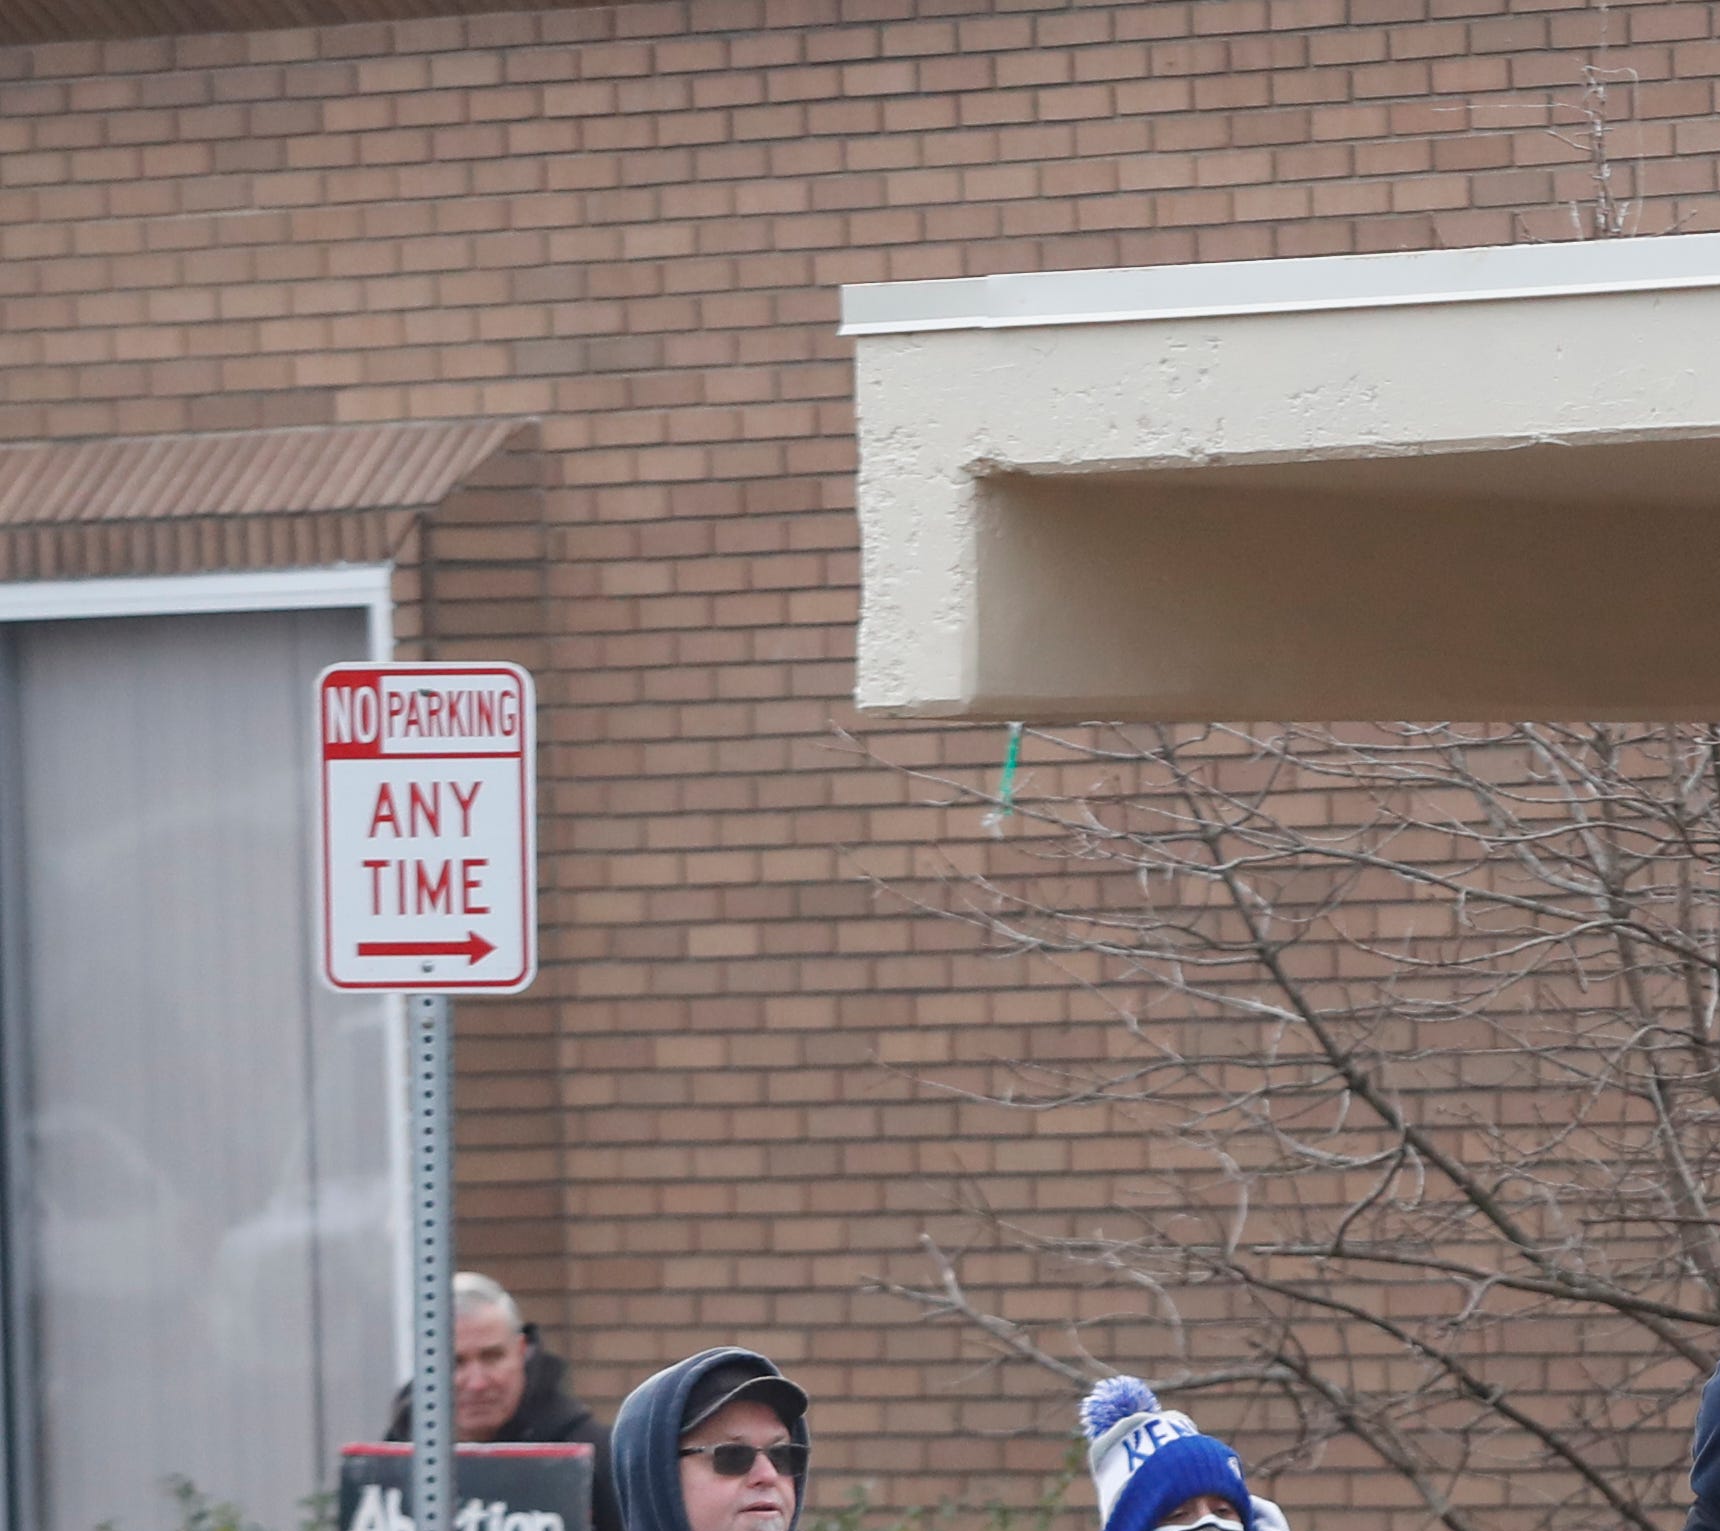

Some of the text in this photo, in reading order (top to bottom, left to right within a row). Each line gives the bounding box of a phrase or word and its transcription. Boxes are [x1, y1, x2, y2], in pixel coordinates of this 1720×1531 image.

[326, 686, 517, 743] NO PARKING
[368, 781, 483, 838] ANY
[362, 859, 490, 915] TIME
